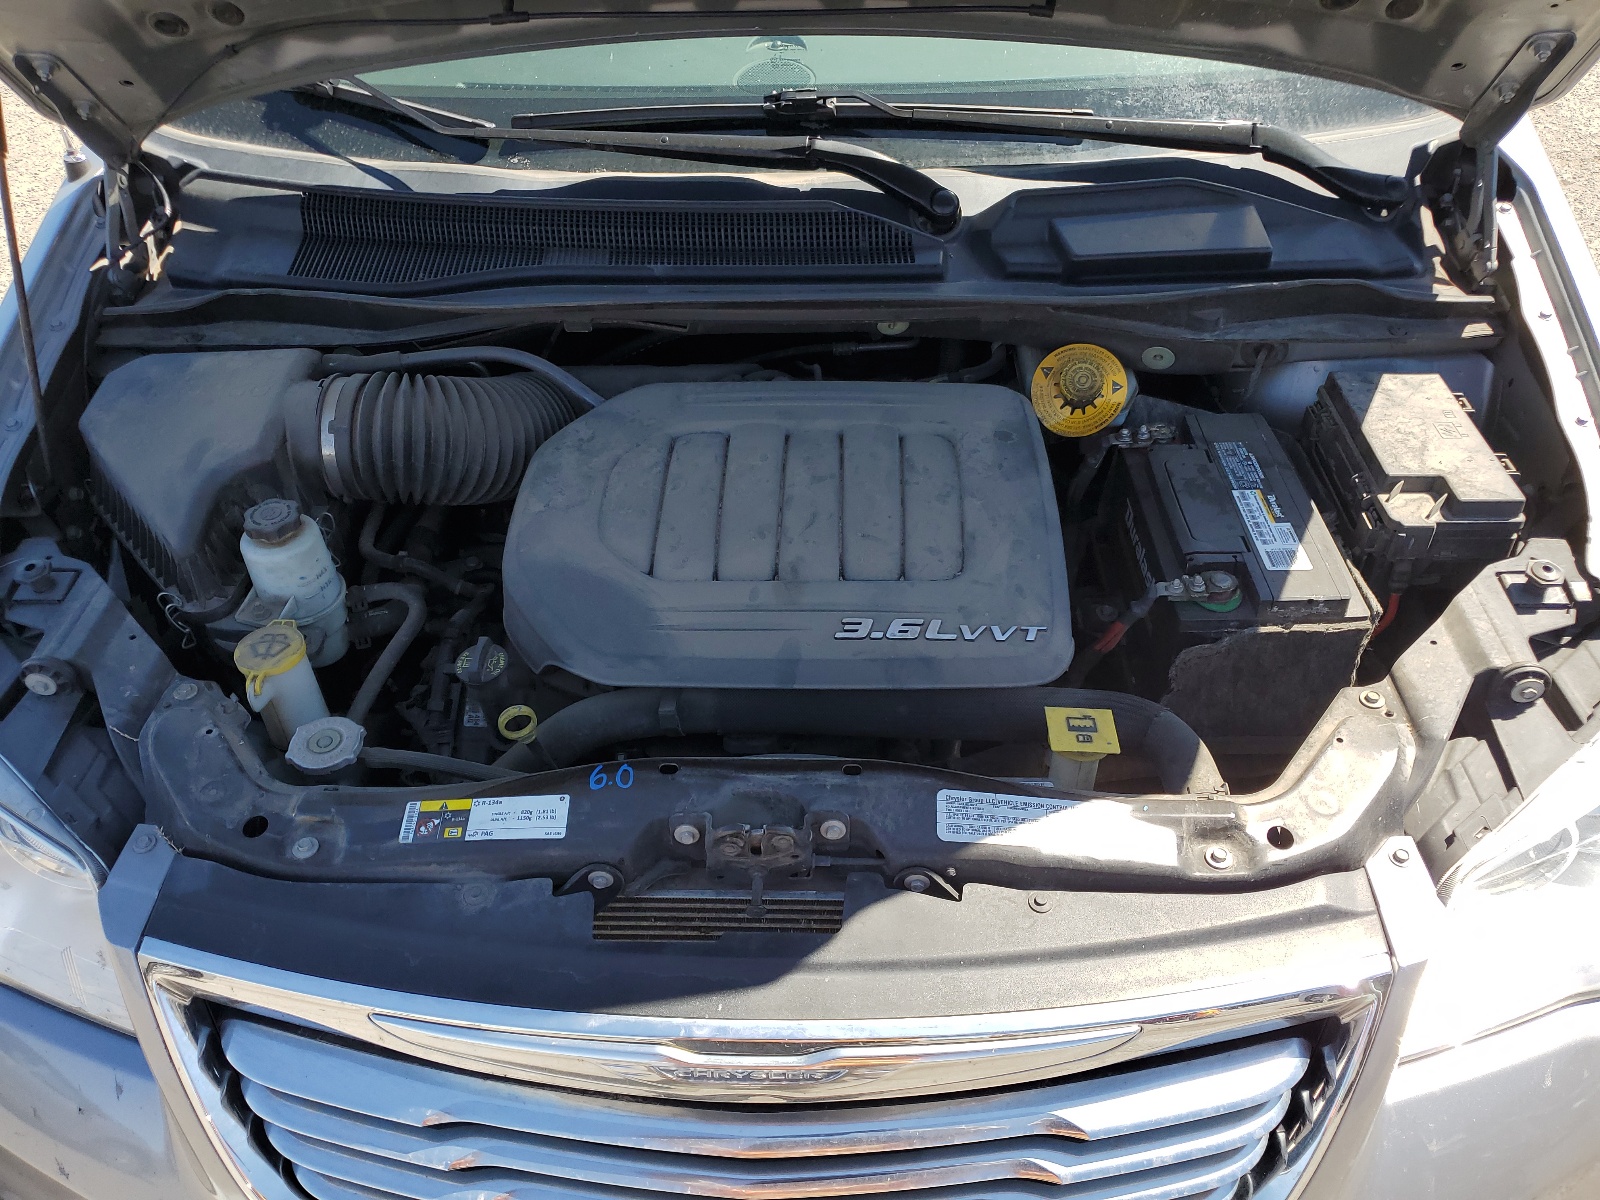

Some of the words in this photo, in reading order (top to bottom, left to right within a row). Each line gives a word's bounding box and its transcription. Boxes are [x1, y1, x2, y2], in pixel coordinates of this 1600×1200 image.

[959, 624, 1047, 642] VVT
[589, 763, 634, 790] 6.0
[673, 1067, 824, 1080] CHRYSLER
